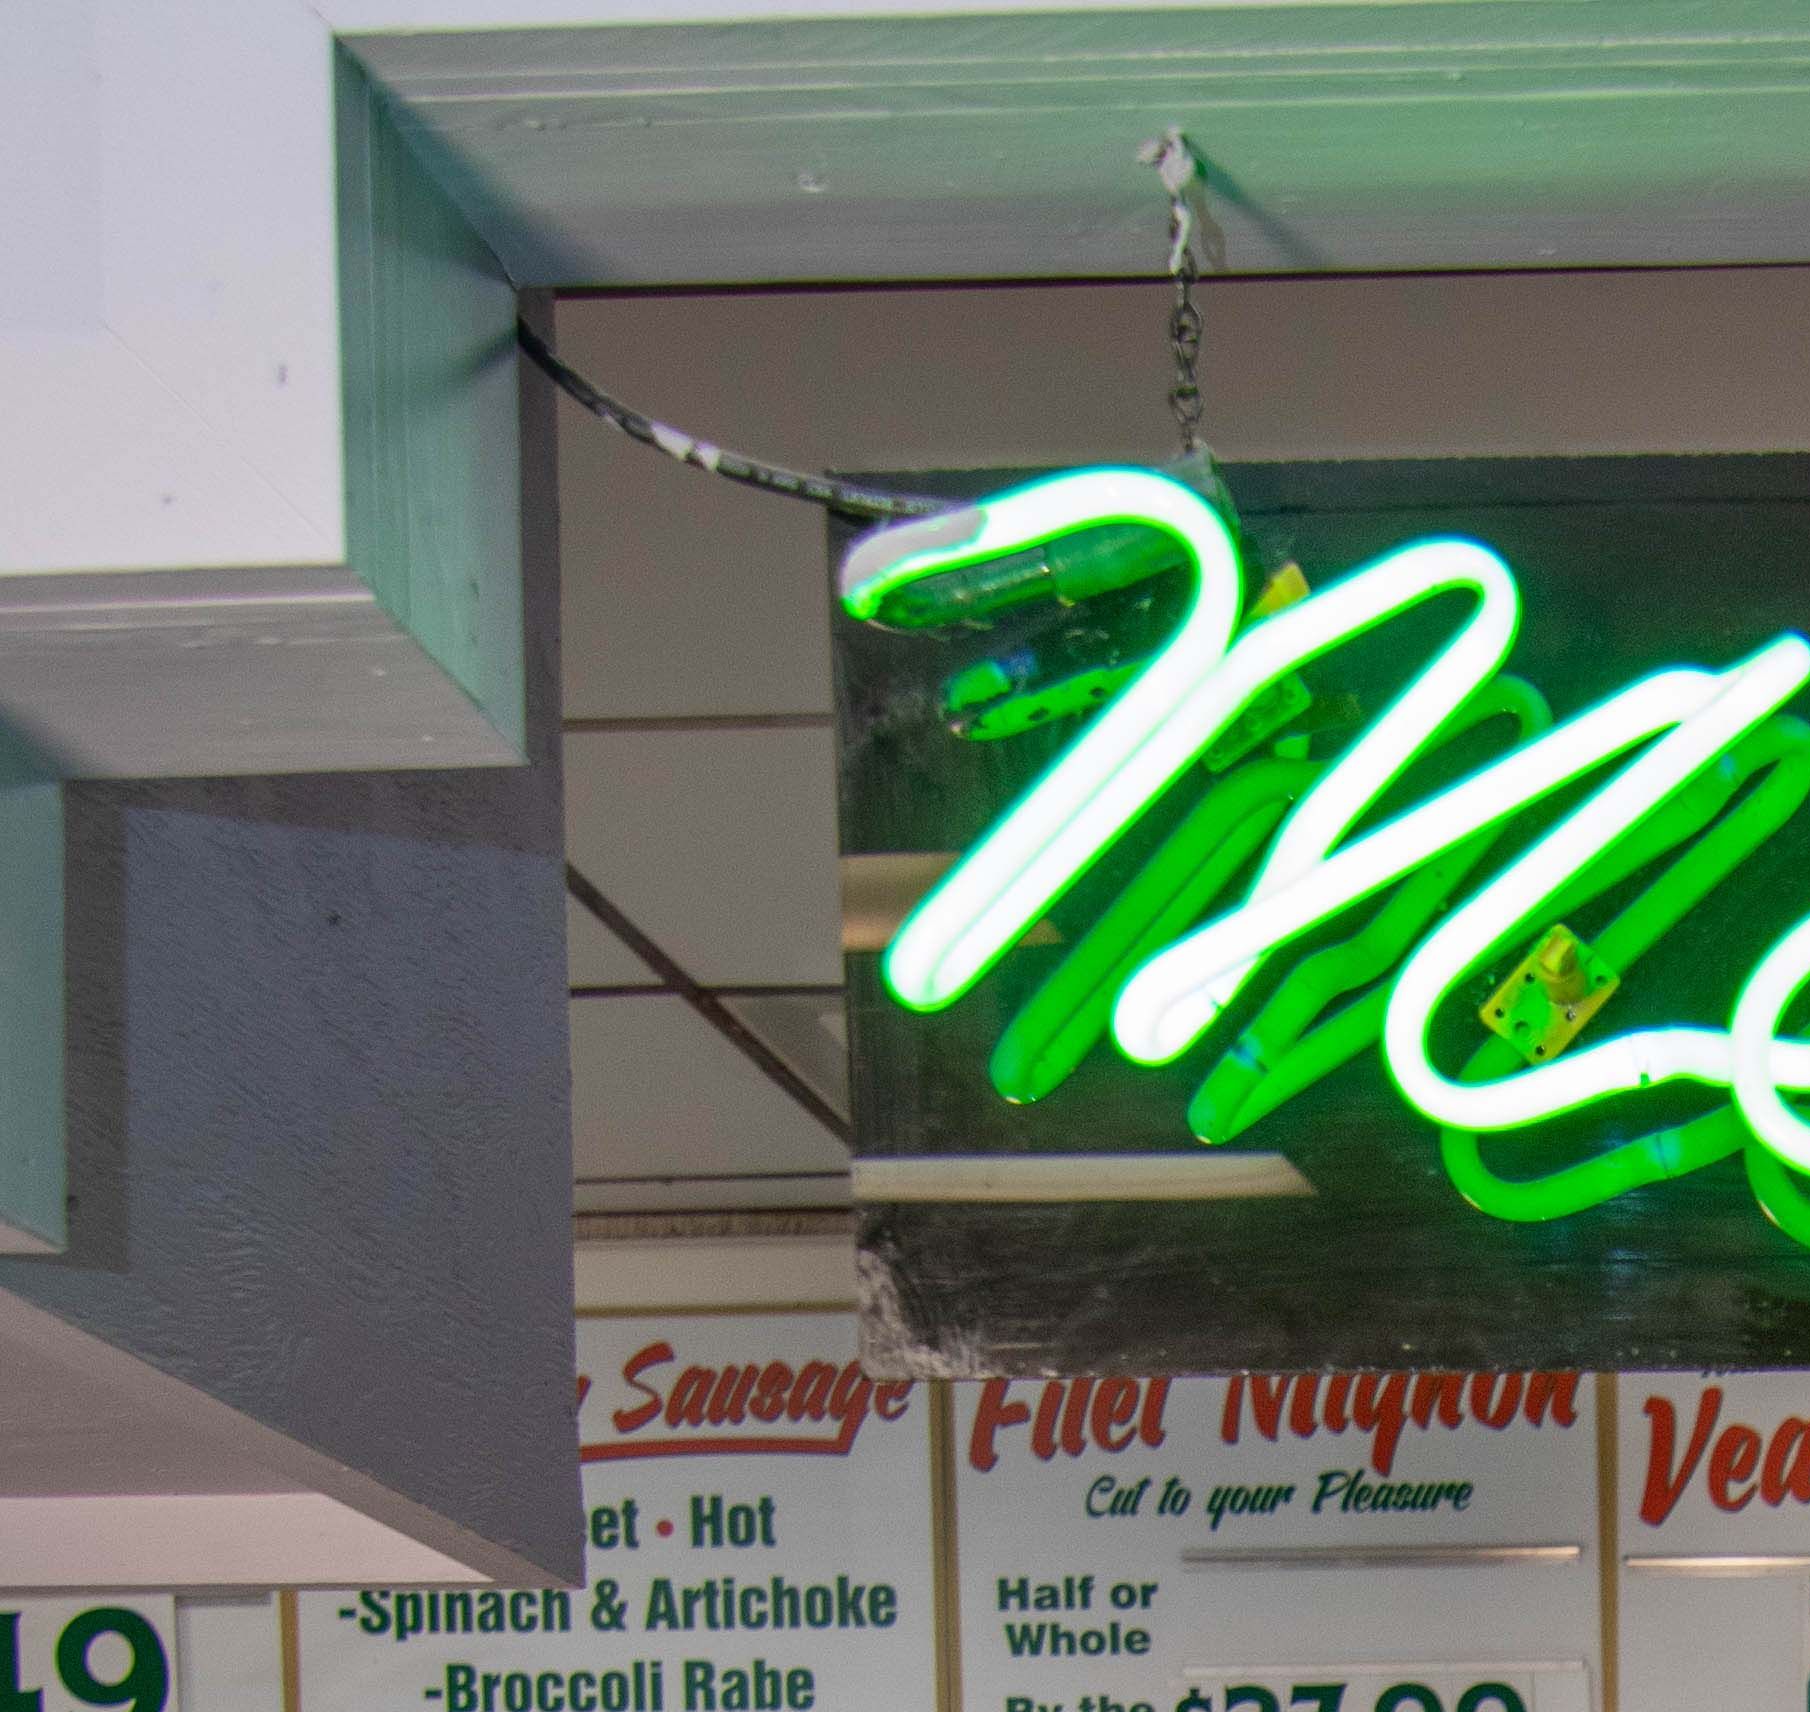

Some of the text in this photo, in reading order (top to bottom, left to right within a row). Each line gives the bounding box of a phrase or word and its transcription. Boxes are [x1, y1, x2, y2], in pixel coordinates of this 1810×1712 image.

[612, 1340, 913, 1456] Sausage
[690, 1495, 777, 1548] Hot
[1086, 1468, 1474, 1532] Cut to your Pleasure
[591, 1576, 628, 1632] &
[645, 1576, 898, 1632] Artichoke
[995, 1576, 1159, 1612] Half or
[1003, 1623, 1154, 1657] Whole
[683, 1659, 817, 1712] Rabe
